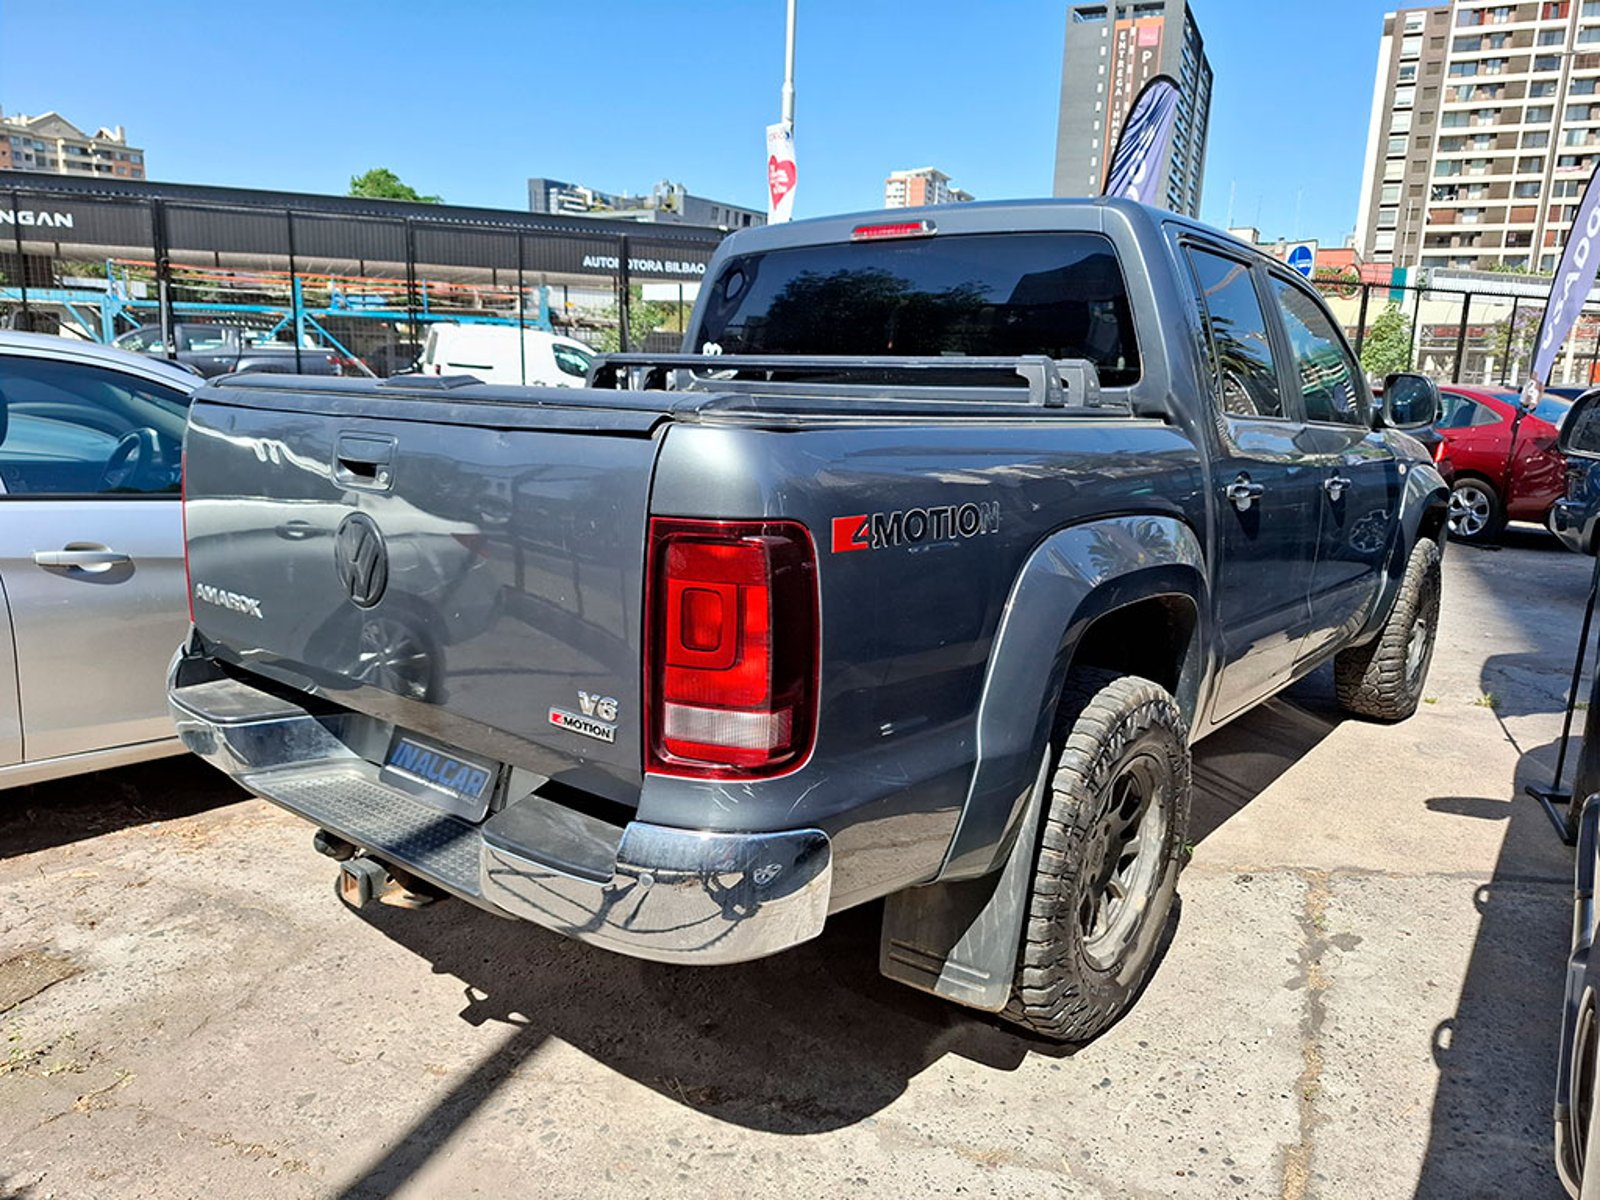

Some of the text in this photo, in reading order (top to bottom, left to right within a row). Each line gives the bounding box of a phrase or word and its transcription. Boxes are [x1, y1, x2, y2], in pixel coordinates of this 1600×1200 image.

[1115, 31, 1127, 96] ENTREGA
[583, 255, 706, 275] AUTOOTORA BILBAO
[845, 501, 1000, 550] 4MOTION
[196, 583, 264, 619] AMAROK
[577, 689, 619, 722] V6
[390, 740, 486, 798] INALCAR
